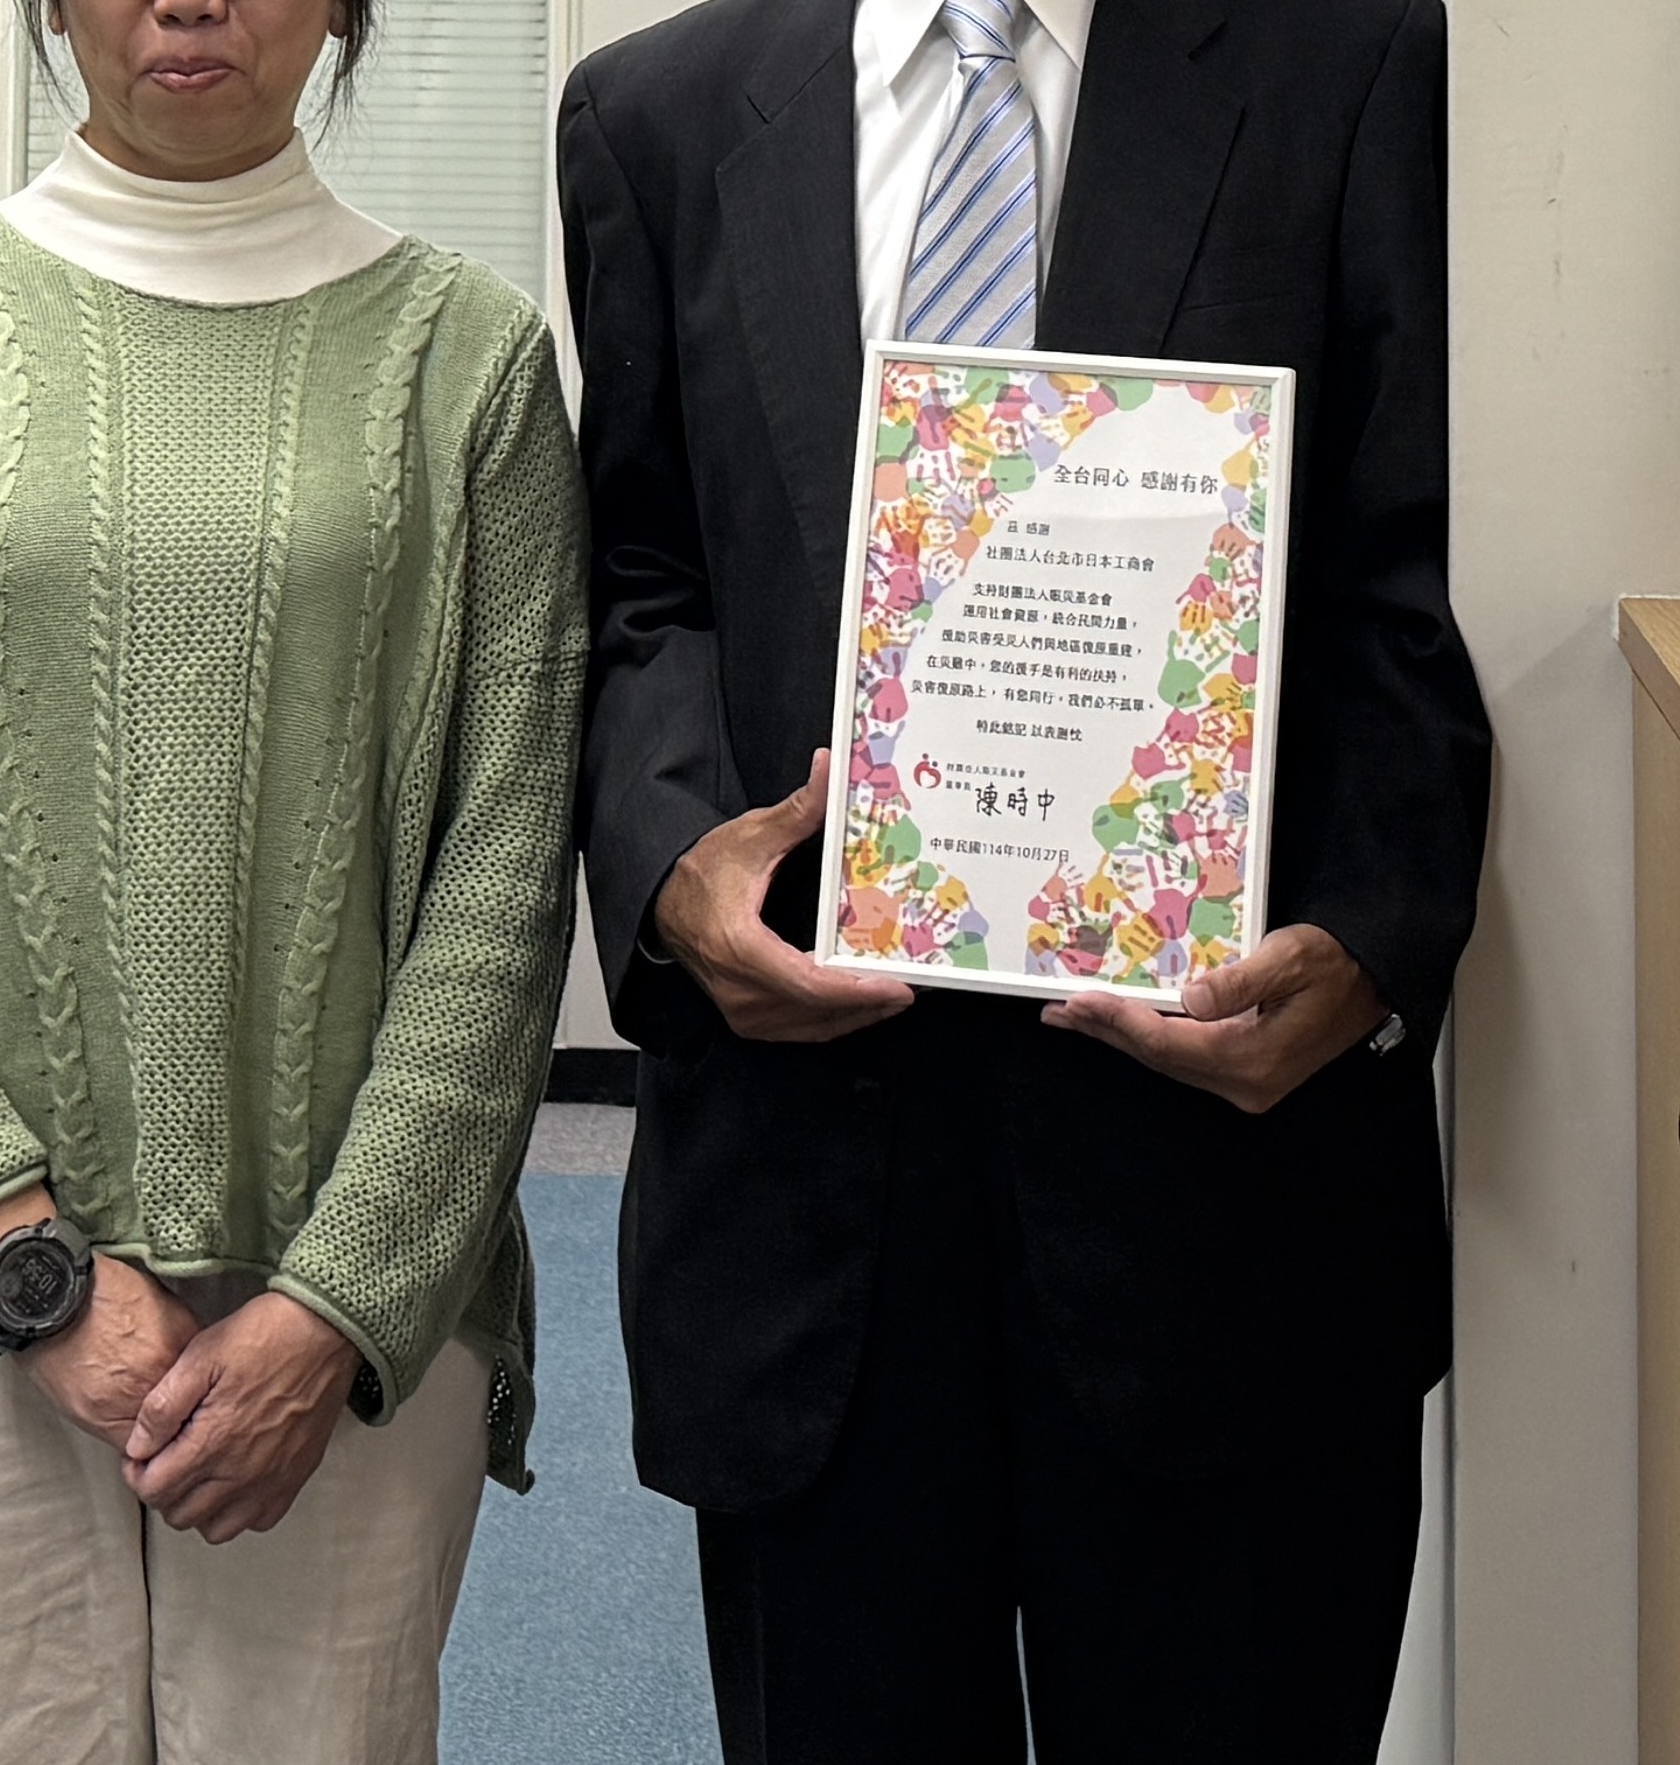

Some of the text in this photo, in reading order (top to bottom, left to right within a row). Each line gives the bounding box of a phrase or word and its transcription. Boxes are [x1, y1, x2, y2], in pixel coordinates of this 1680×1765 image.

[1053, 464, 1218, 495] 全台同心 感謝有你
